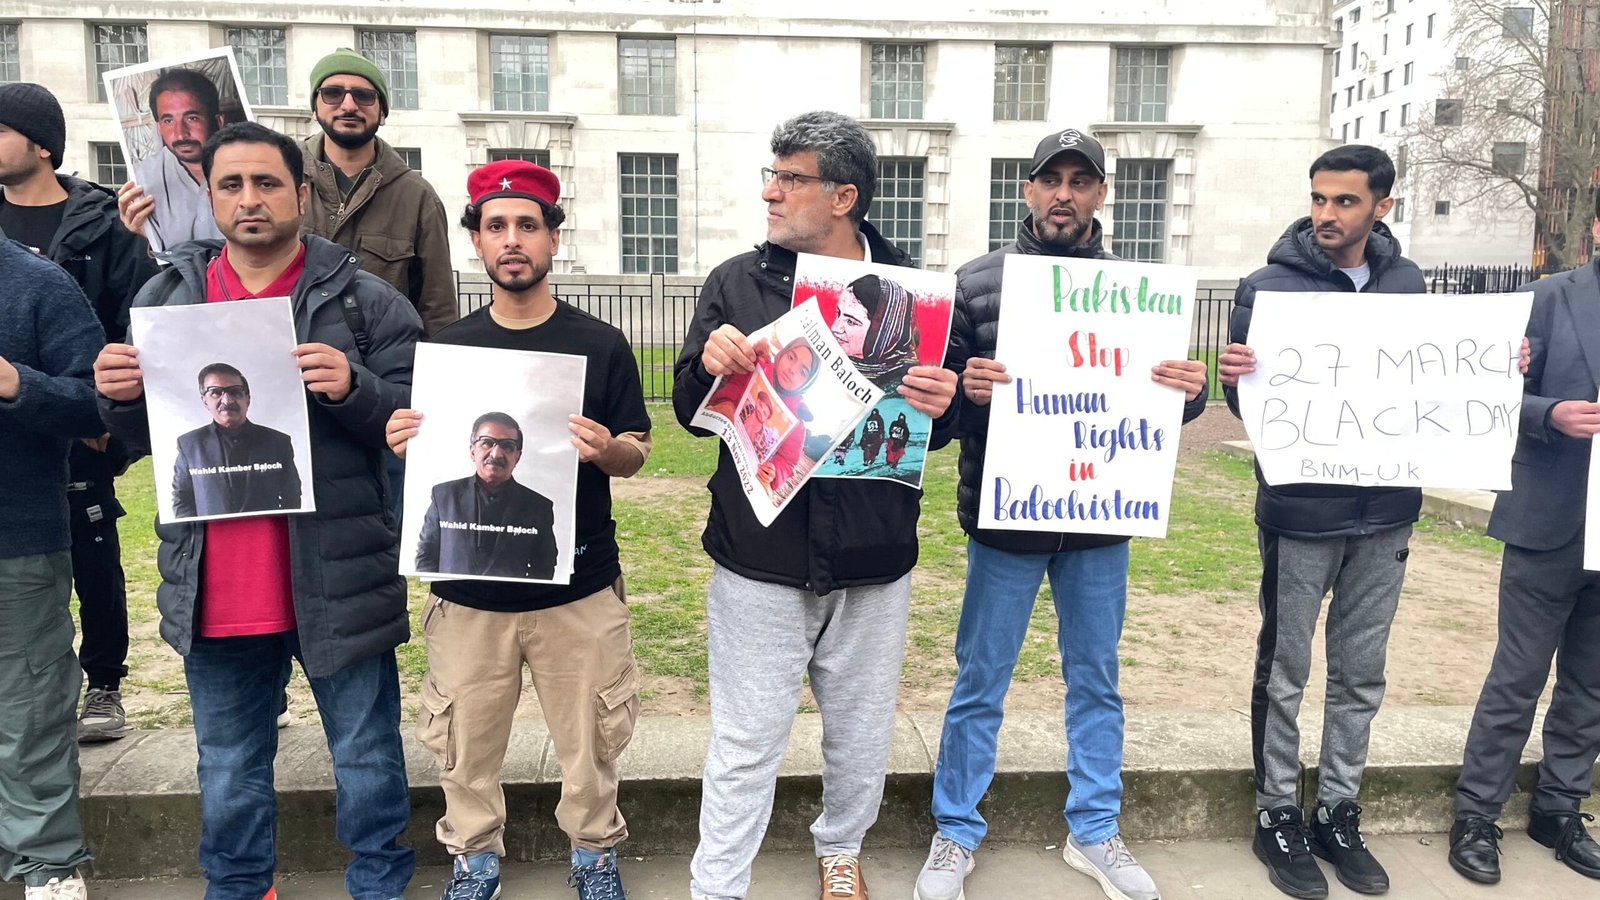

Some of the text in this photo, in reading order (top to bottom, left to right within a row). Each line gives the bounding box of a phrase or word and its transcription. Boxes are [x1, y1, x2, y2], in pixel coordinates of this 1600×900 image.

[1053, 265, 1182, 315] Pakistan
[1066, 331, 1130, 376] Stop
[1269, 344, 1349, 387] 27
[830, 356, 872, 404] Baloch
[1017, 378, 1110, 415] Human
[1074, 417, 1165, 463] Rights
[1261, 398, 1521, 450] BLACK DAY
[189, 462, 282, 476] Wahid Kamber Baloch
[721, 428, 753, 495] 13 Nov 2022
[1069, 459, 1098, 481] in
[994, 477, 1160, 521] Balochistan
[440, 520, 538, 536] Wahid Kamber Baloch
